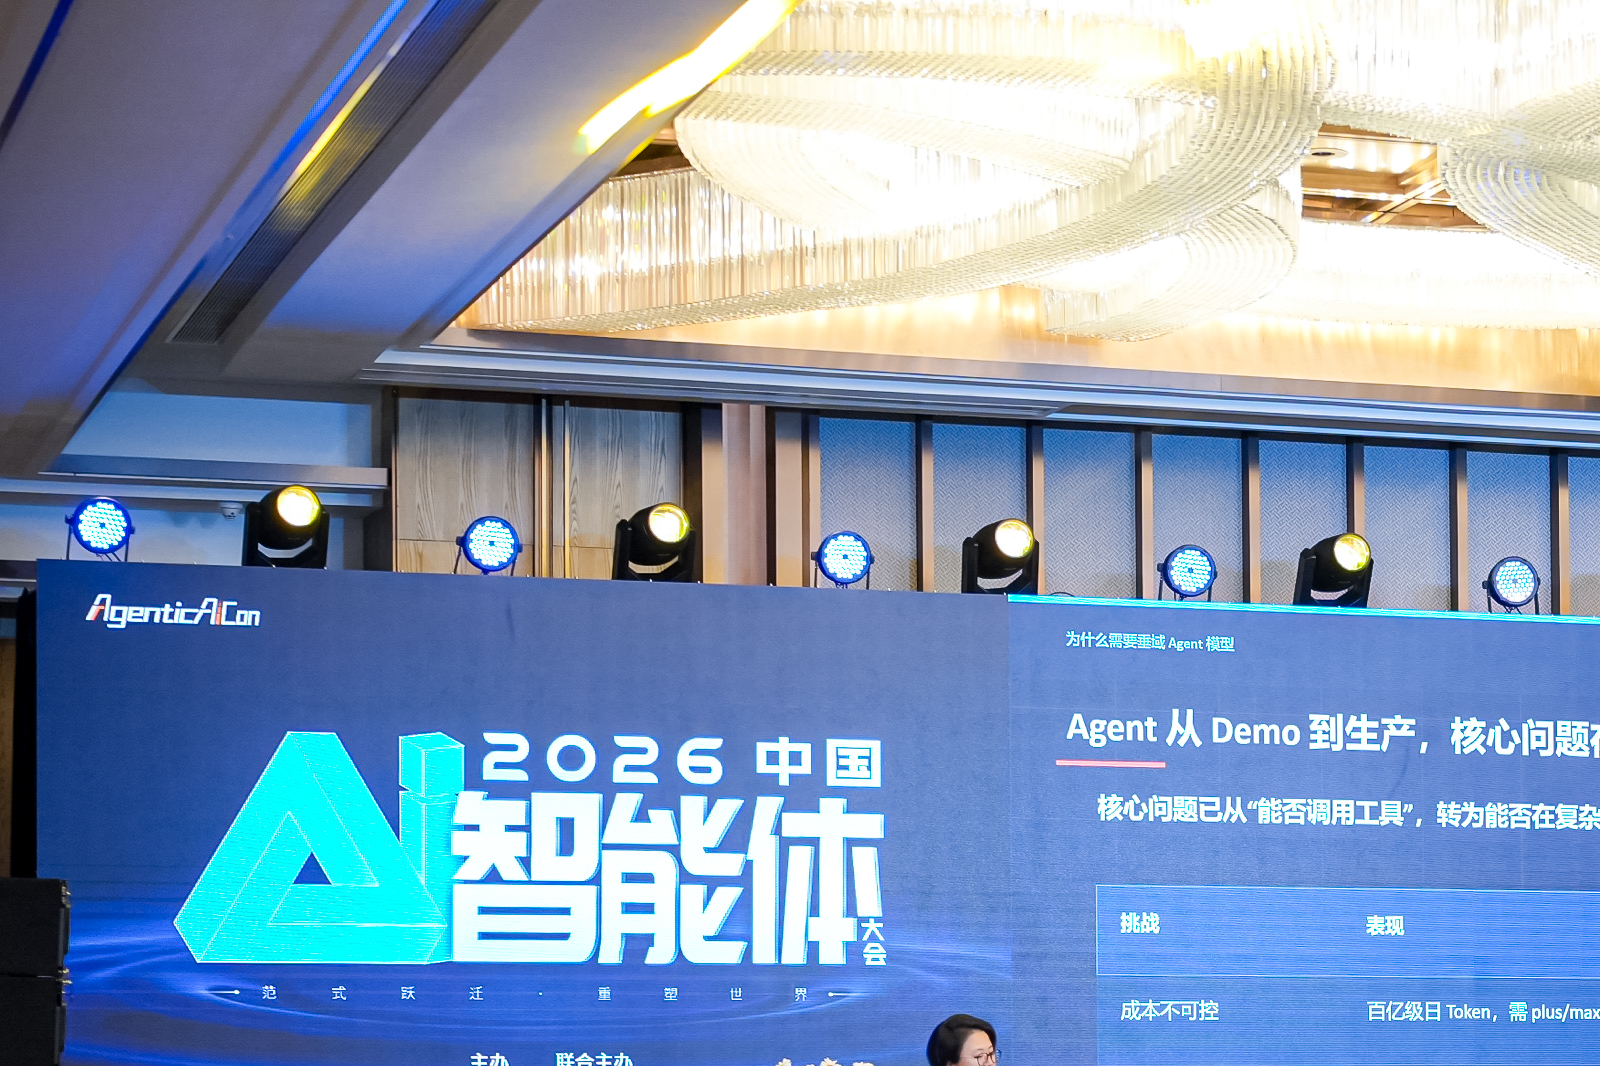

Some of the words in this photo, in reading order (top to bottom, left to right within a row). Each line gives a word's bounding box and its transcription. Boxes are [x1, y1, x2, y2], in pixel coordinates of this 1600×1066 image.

[1065, 630, 1166, 650] 为什么需要垂域
[1167, 636, 1204, 652] Agent
[1205, 635, 1236, 652] 模型
[1066, 713, 1158, 748] Agent
[1165, 708, 1203, 748] 从
[1212, 717, 1301, 746] Demo
[482, 732, 724, 785] 2026
[756, 736, 882, 788] 中国
[450, 788, 886, 967] 智能体
[1120, 911, 1161, 935] 挑战
[1365, 914, 1405, 937] 表现
[859, 917, 889, 968] 大会
[1120, 998, 1220, 1022] 成本不可控
[1366, 1000, 1441, 1022] 百亿级日
[1531, 1003, 1600, 1024] plus/max
